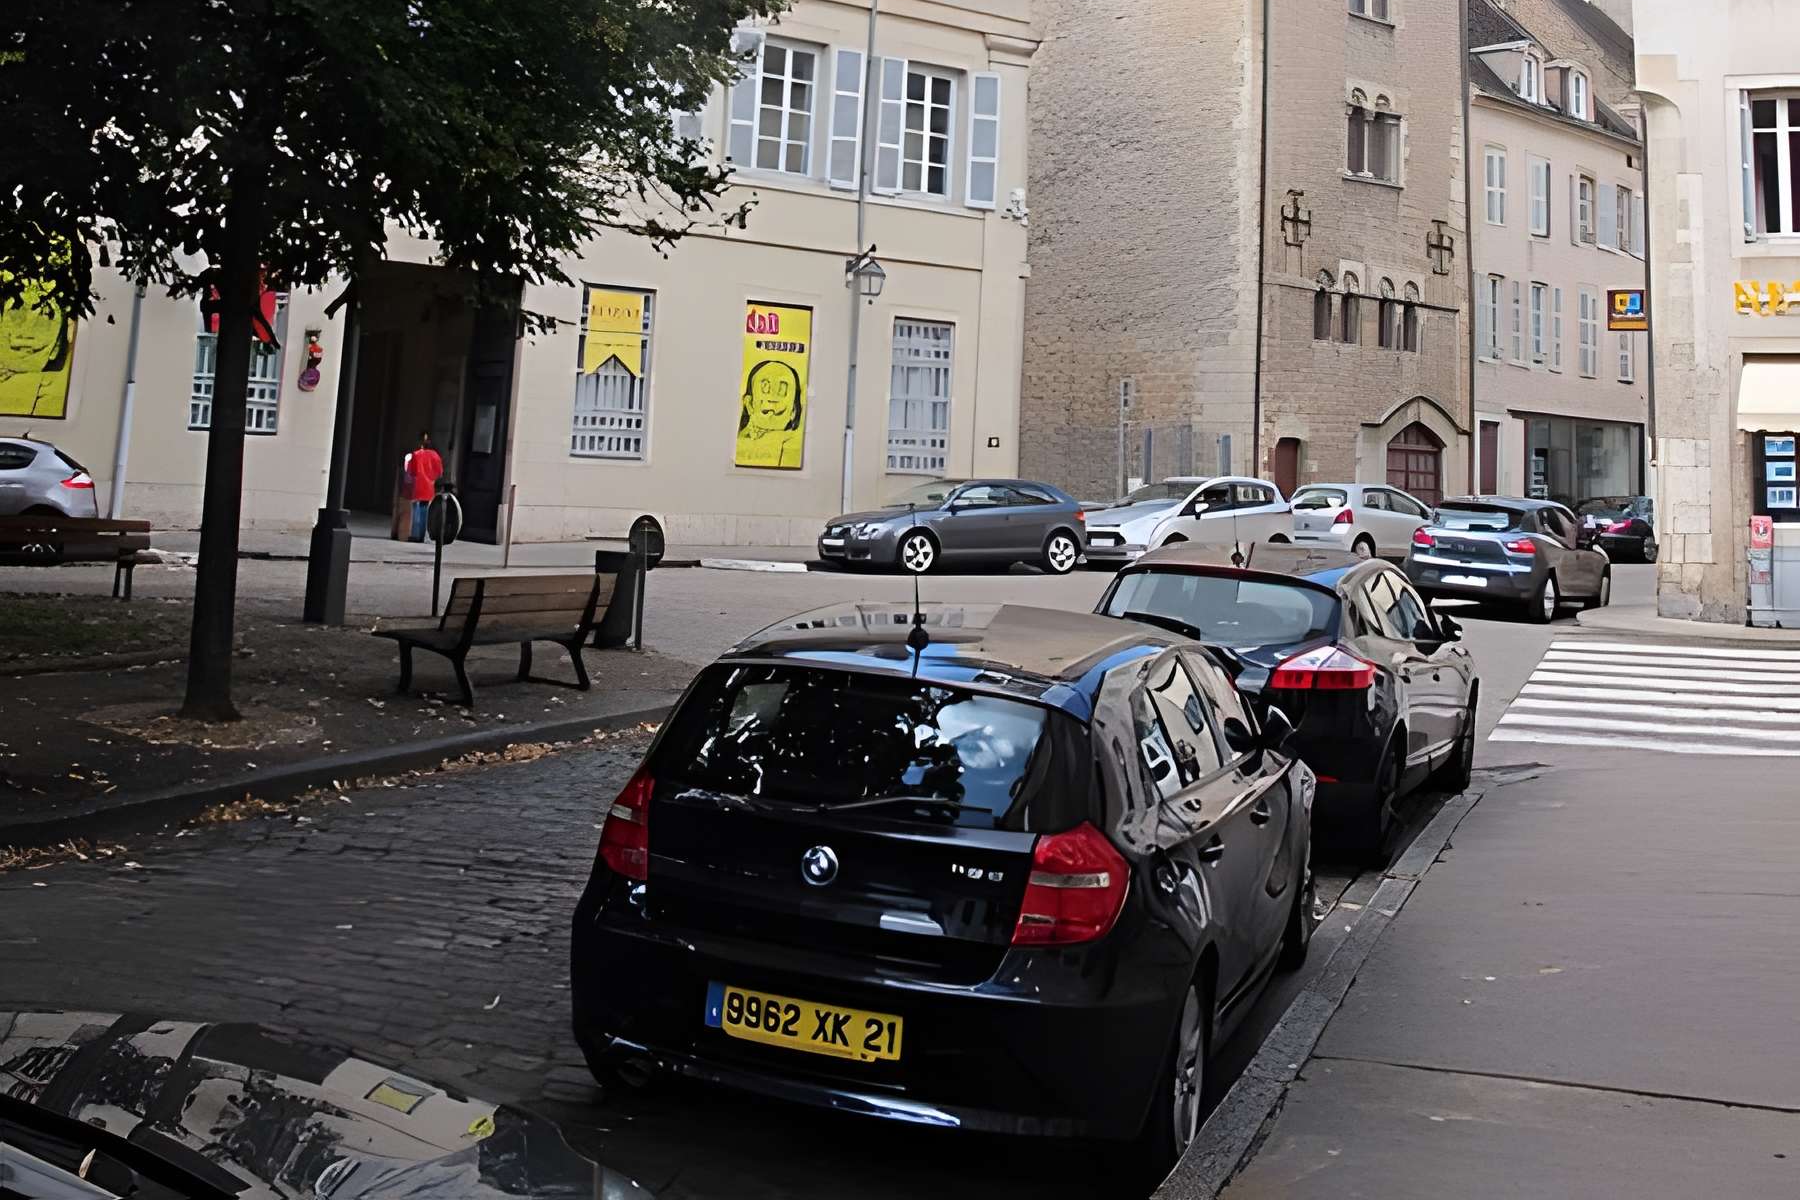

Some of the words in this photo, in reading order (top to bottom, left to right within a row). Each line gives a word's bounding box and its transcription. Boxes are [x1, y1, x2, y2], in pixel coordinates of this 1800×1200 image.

[727, 992, 800, 1036] 9962
[811, 1009, 852, 1047] XK
[863, 1018, 896, 1054] 21
